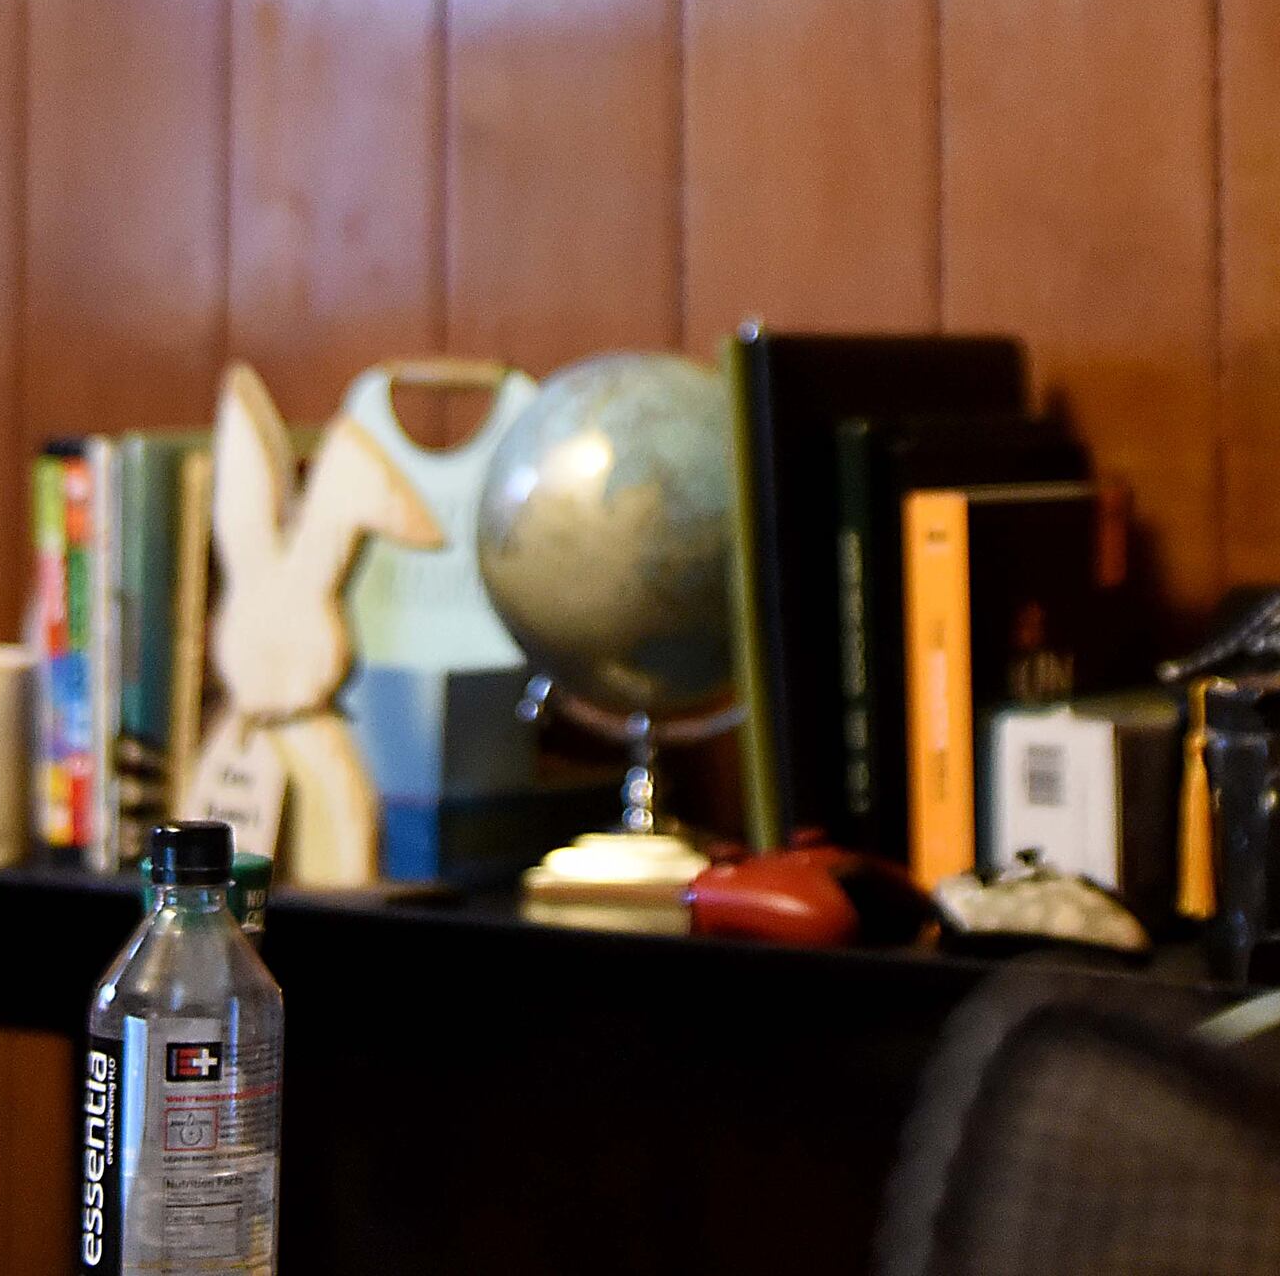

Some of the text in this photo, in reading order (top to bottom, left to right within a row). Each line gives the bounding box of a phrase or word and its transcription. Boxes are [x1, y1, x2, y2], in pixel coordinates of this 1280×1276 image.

[81, 1050, 108, 1266] essentia
[105, 1081, 117, 1165] overachieving
[166, 1179, 215, 1188] Nutrition
